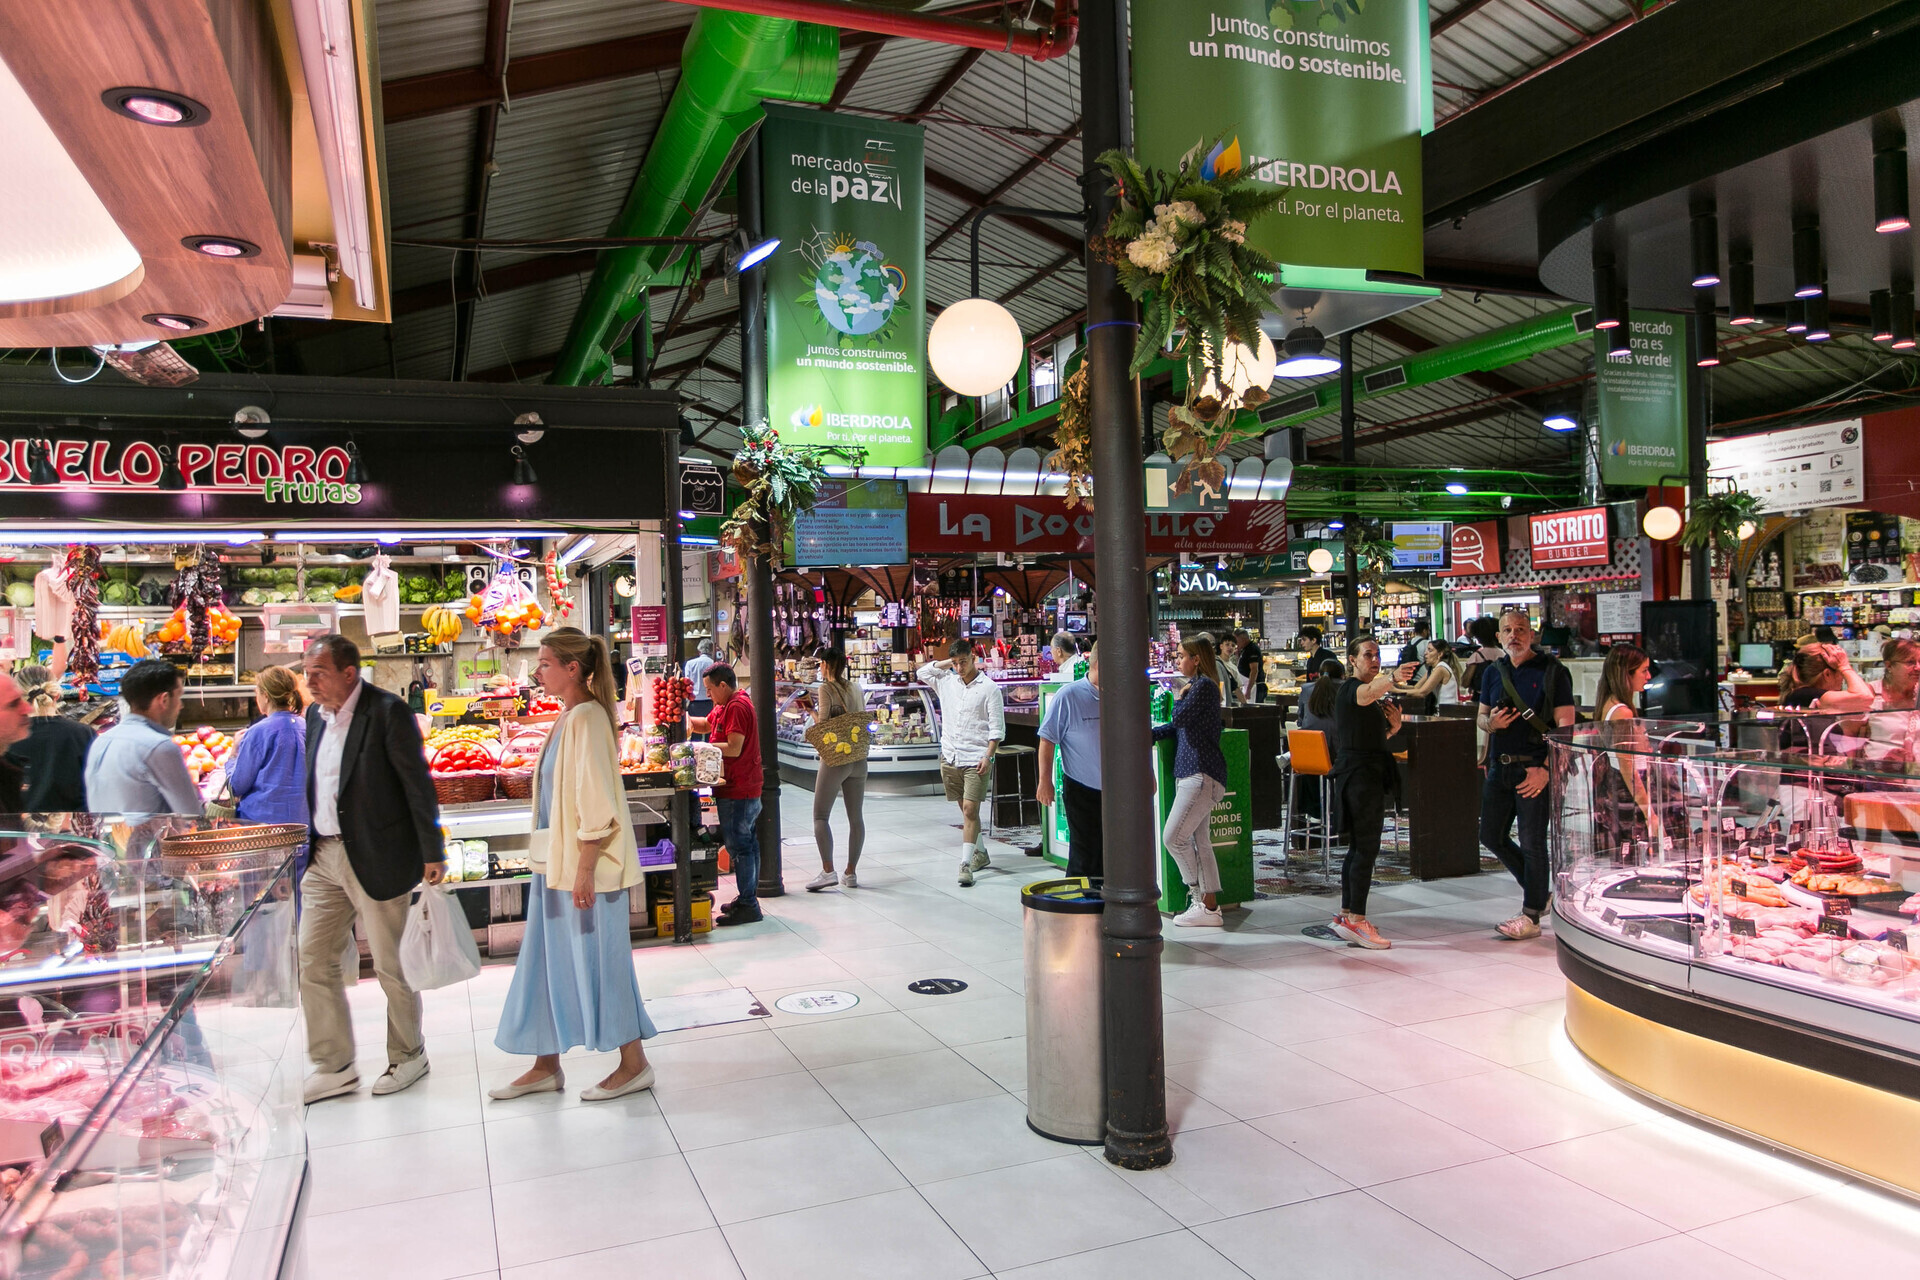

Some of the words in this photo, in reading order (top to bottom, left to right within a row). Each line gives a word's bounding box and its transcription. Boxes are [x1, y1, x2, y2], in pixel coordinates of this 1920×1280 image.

[1208, 12, 1269, 40] Juntos
[1273, 27, 1390, 57] construimos
[1189, 39, 1218, 58] un
[1224, 42, 1294, 70] mundo
[1299, 55, 1407, 85] sostenible.
[791, 152, 863, 174] mercado
[1249, 155, 1402, 196] IBERDROLA
[791, 178, 811, 195] de
[815, 178, 828, 196] la
[831, 174, 888, 203] paz
[1295, 201, 1321, 218] Por
[1326, 203, 1339, 219] el
[1343, 204, 1404, 224] planeta.
[1651, 340, 1663, 351] es
[842, 347, 907, 360] construimos
[1635, 353, 1672, 367] verde!
[796, 358, 812, 367] un
[815, 358, 854, 371] mundo
[856, 359, 916, 373] sostenible.
[826, 413, 912, 430] IBERDROLA
[827, 432, 840, 442] Por
[852, 432, 867, 443] Por
[868, 433, 877, 443] el
[878, 433, 913, 446] planeta.
[1628, 445, 1676, 457] IBERDROLA
[179, 443, 352, 487] PEDRO
[265, 477, 362, 504] Frutas
[1798, 494, 1858, 506] www.laboulette.com
[1532, 513, 1605, 546] DISTRITO
[1174, 538, 1194, 549] alta
[1196, 540, 1254, 552] gastronomía
[1548, 547, 1589, 560] BURGER
[1304, 598, 1334, 613] Tienda
[1230, 813, 1242, 822] DE
[1212, 826, 1242, 837] VIDRIO
